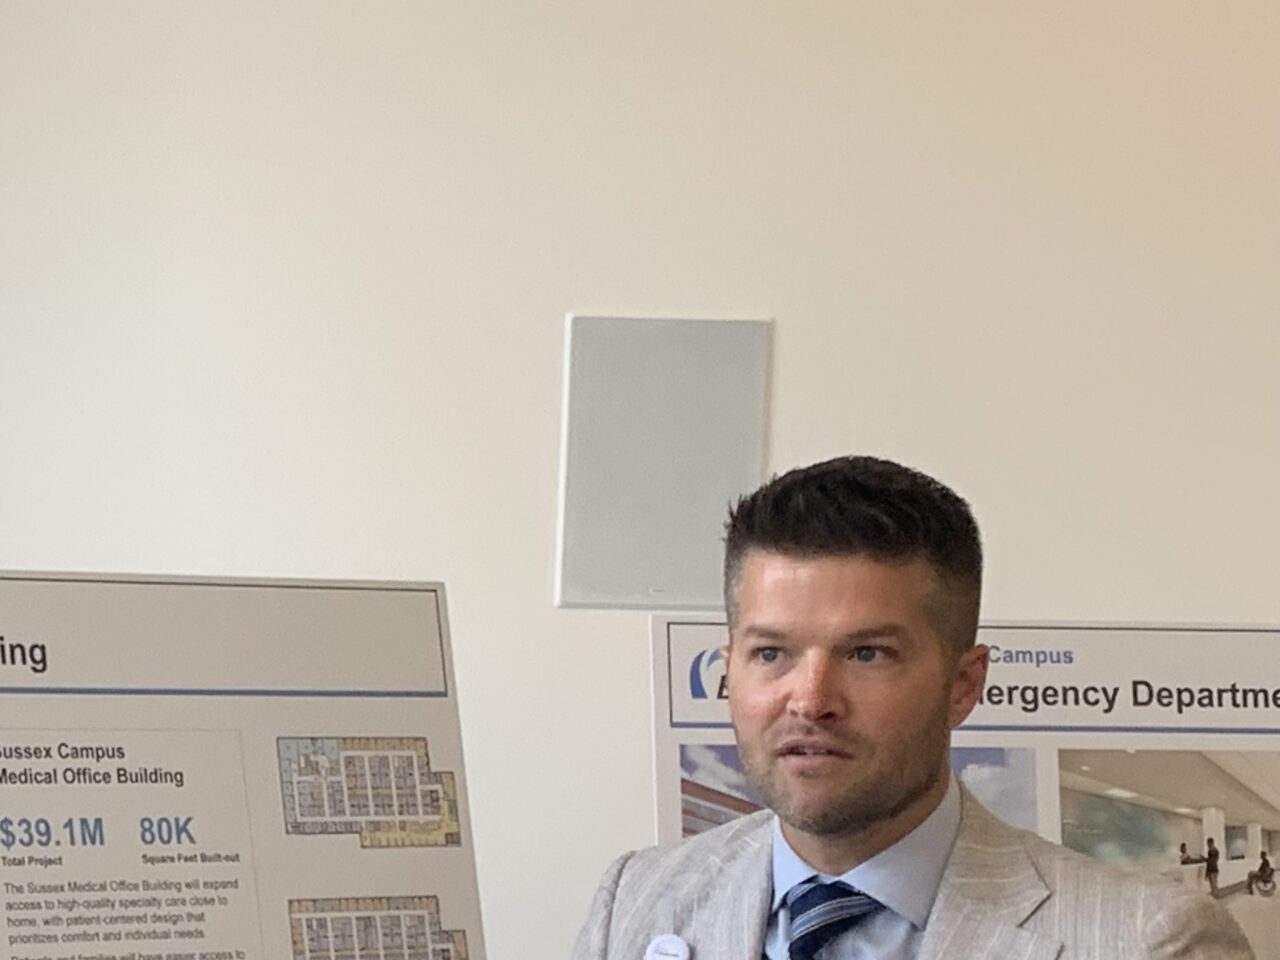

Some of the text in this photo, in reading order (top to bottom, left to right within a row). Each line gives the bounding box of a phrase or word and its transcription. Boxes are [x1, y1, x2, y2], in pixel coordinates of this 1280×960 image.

[988, 645, 1073, 667] Campus
[979, 684, 1119, 713] ergency
[58, 744, 125, 762] Campus
[63, 768, 111, 783] Office
[117, 769, 184, 787] Building
[0, 817, 104, 850] $39.1M
[140, 817, 195, 844] 80K
[2, 856, 62, 868] Total Project
[142, 854, 174, 865] Square
[178, 854, 197, 863] Feet
